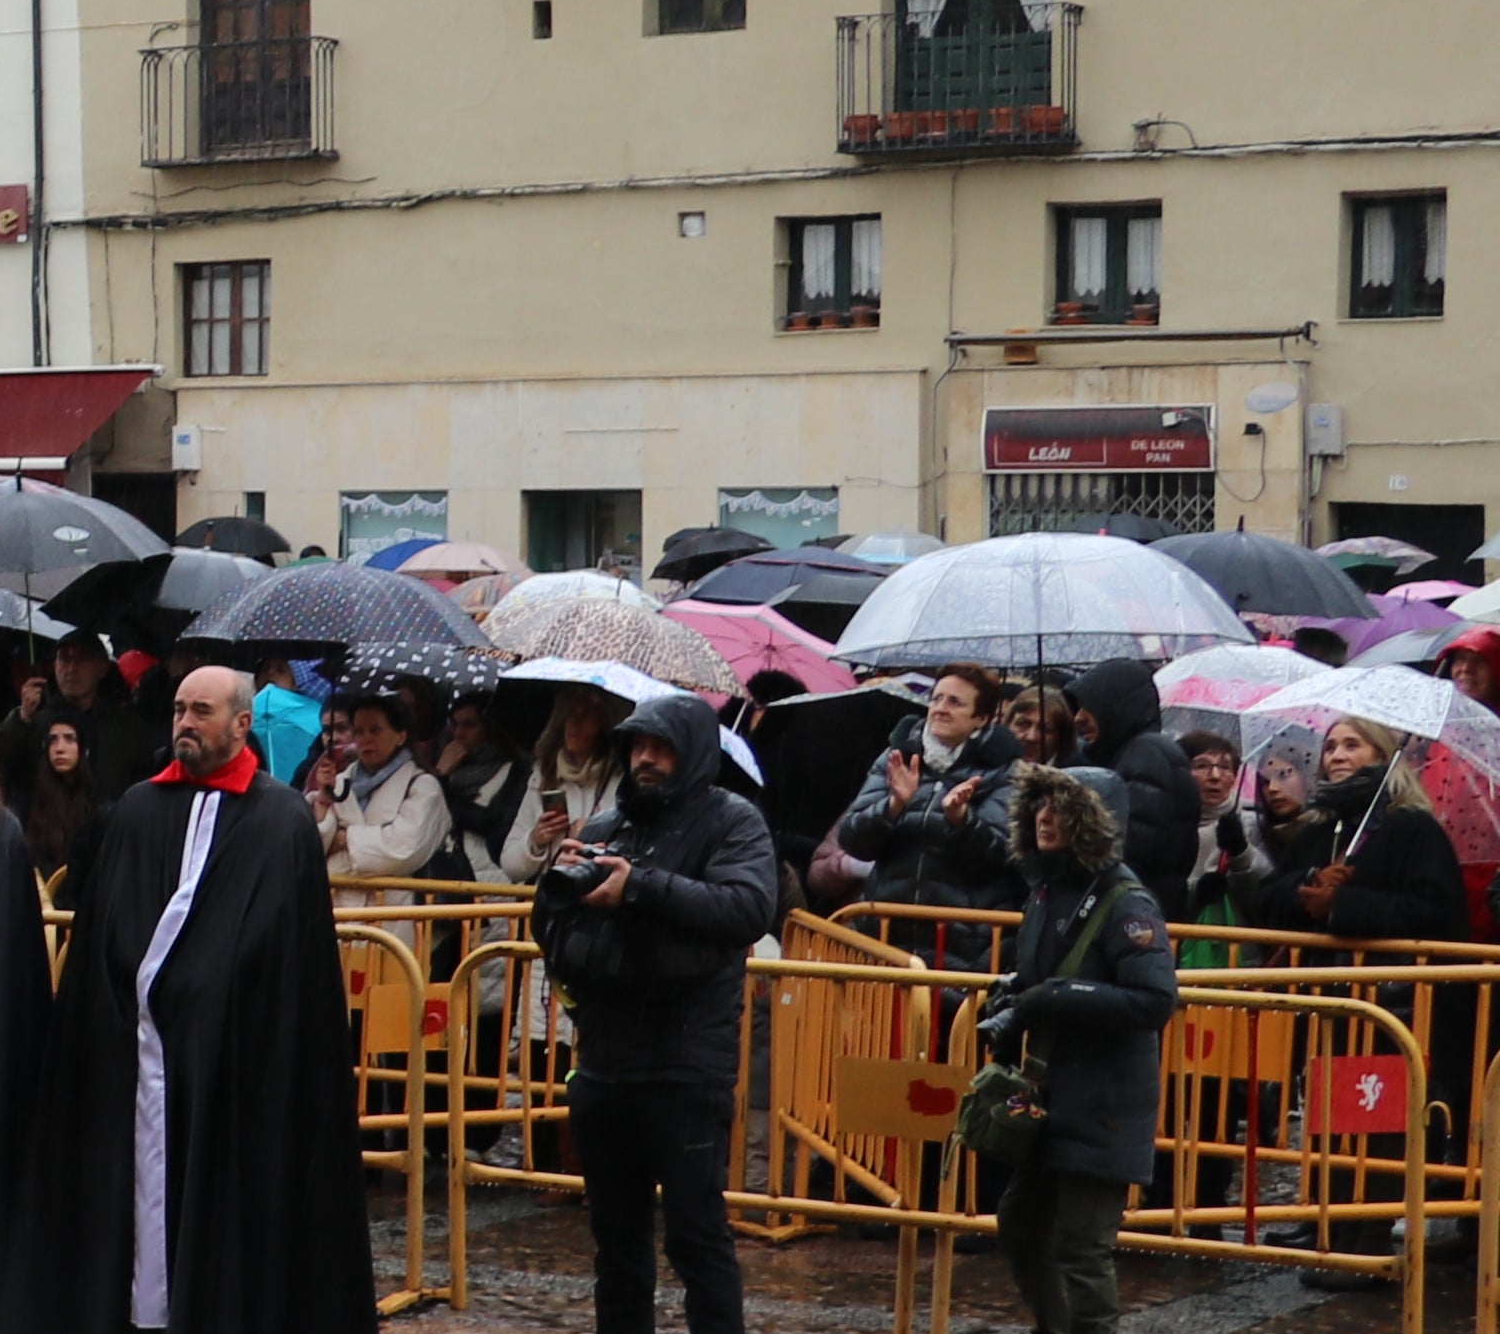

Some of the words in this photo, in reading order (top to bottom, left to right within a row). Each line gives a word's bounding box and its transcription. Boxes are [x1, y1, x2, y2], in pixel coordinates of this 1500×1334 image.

[1028, 441, 1071, 461] LEÓN
[1131, 439, 1148, 451] DE
[1145, 452, 1171, 463] PAN
